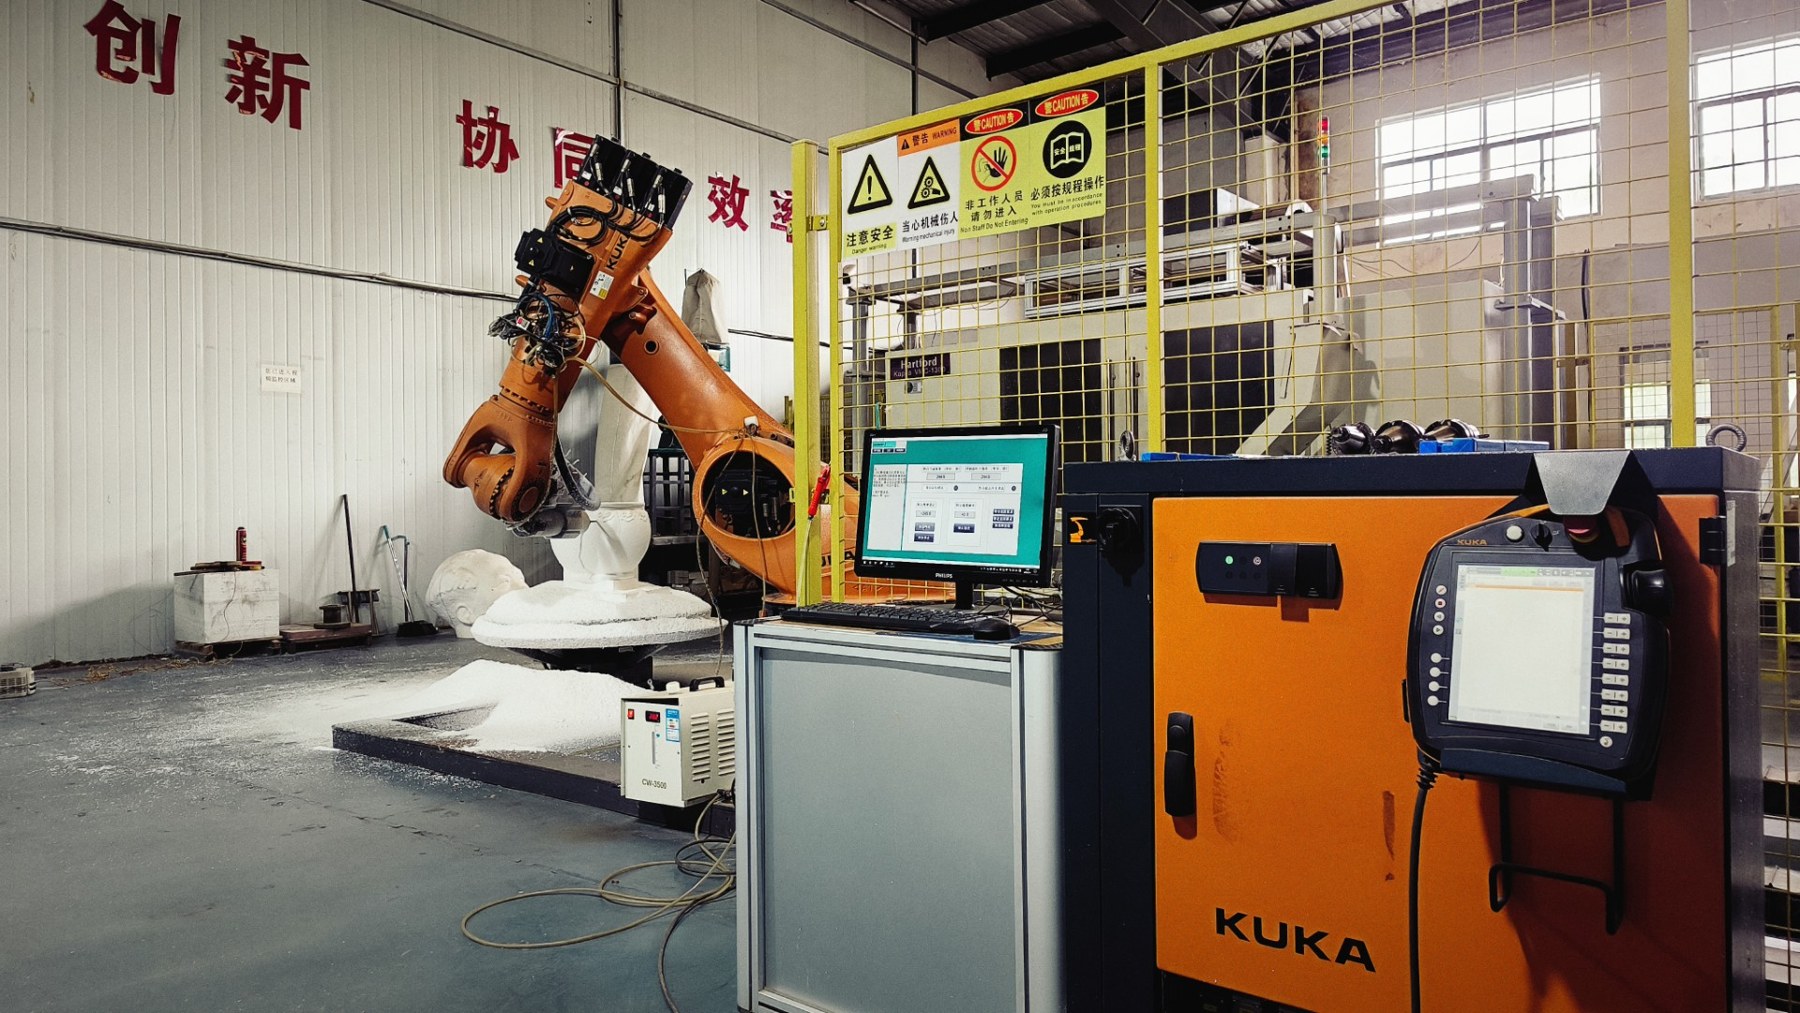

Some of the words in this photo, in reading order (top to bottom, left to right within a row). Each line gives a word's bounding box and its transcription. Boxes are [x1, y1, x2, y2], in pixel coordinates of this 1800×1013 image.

[83, 0, 310, 130] 创新
[912, 133, 928, 146] 警告
[932, 127, 957, 140] WARNING
[1031, 175, 1104, 201] 必须按规程操作
[965, 190, 1024, 210] 非工作人员
[1032, 208, 1043, 216] with
[1045, 204, 1070, 214] operation
[1072, 199, 1101, 209] procedures
[902, 211, 958, 233] 当心机械伤人
[971, 206, 1017, 223] 请勿进入
[972, 223, 985, 231] Staff
[986, 222, 993, 230] Do
[1005, 217, 1028, 227] Entering
[846, 225, 893, 248] 注意安全
[606, 236, 629, 271] KUK
[852, 247, 867, 255] Danger
[1215, 907, 1376, 973] KUKA
